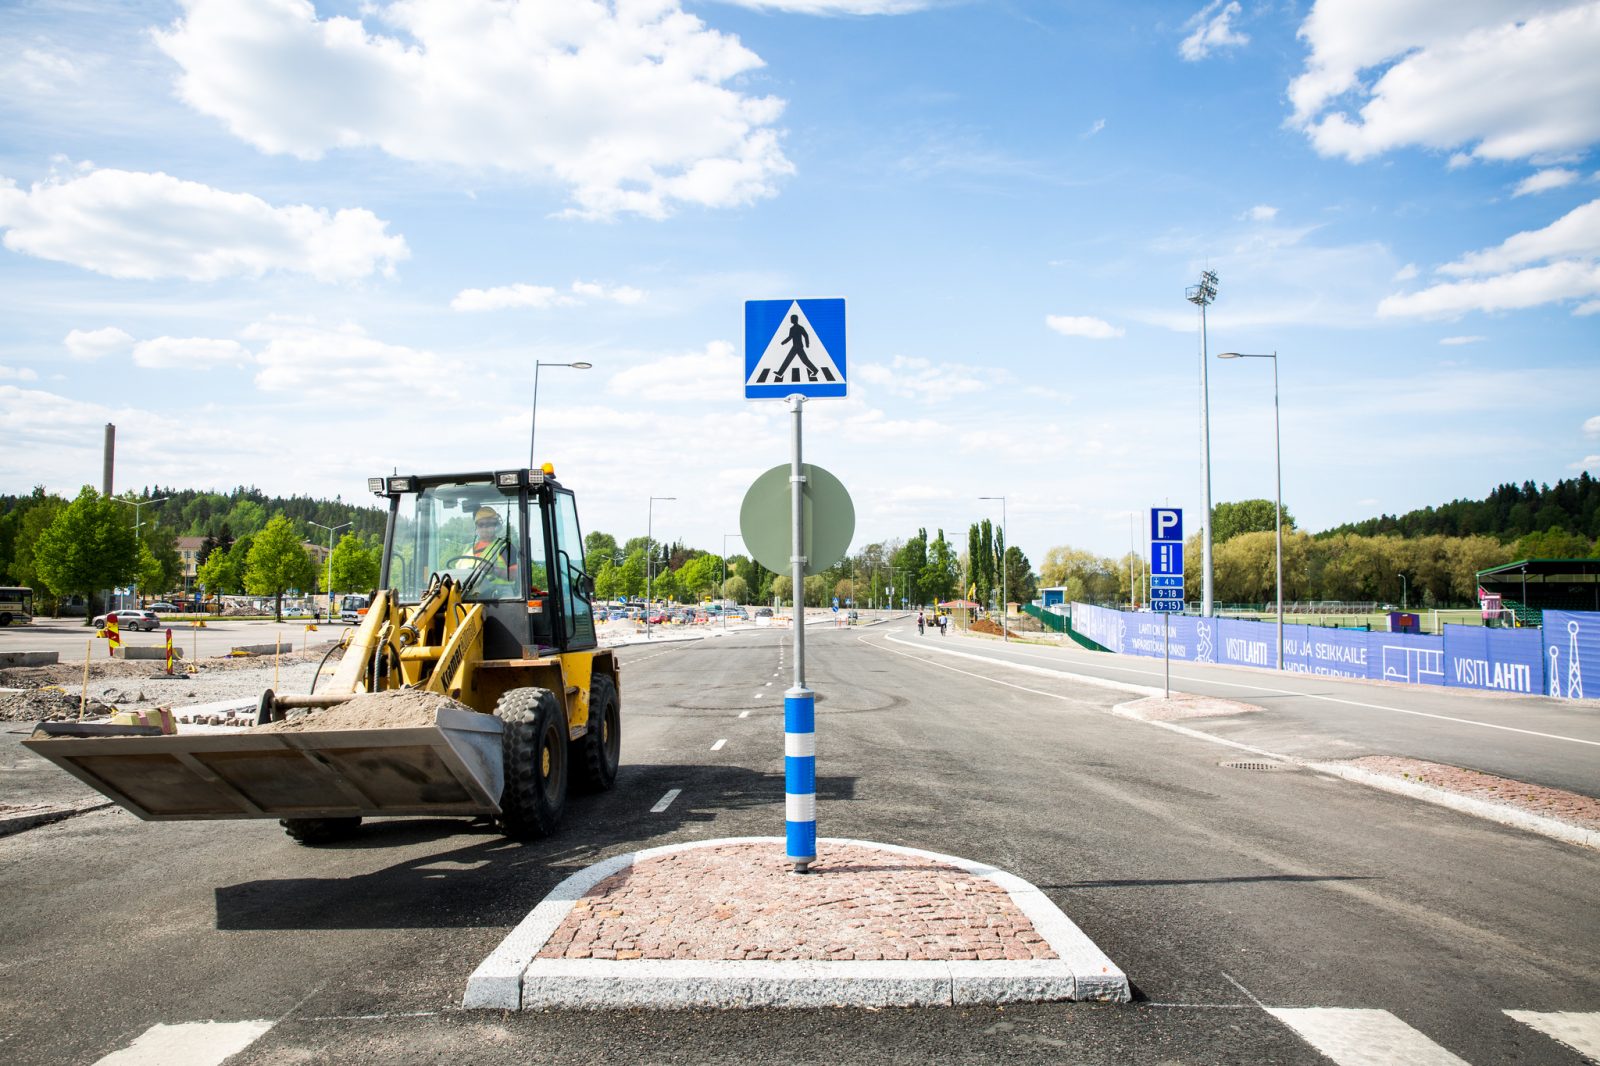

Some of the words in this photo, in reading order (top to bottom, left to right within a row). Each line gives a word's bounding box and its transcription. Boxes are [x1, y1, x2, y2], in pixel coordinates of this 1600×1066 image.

[1157, 510, 1178, 539] P
[1154, 601, 1181, 610] (9-15)
[1158, 590, 1177, 598] 9-18
[1225, 637, 1267, 665] VISITLAHTI
[1299, 641, 1313, 657] JA
[1315, 643, 1368, 665] SEIKKAILE
[1454, 657, 1530, 692] VISITLAHTI
